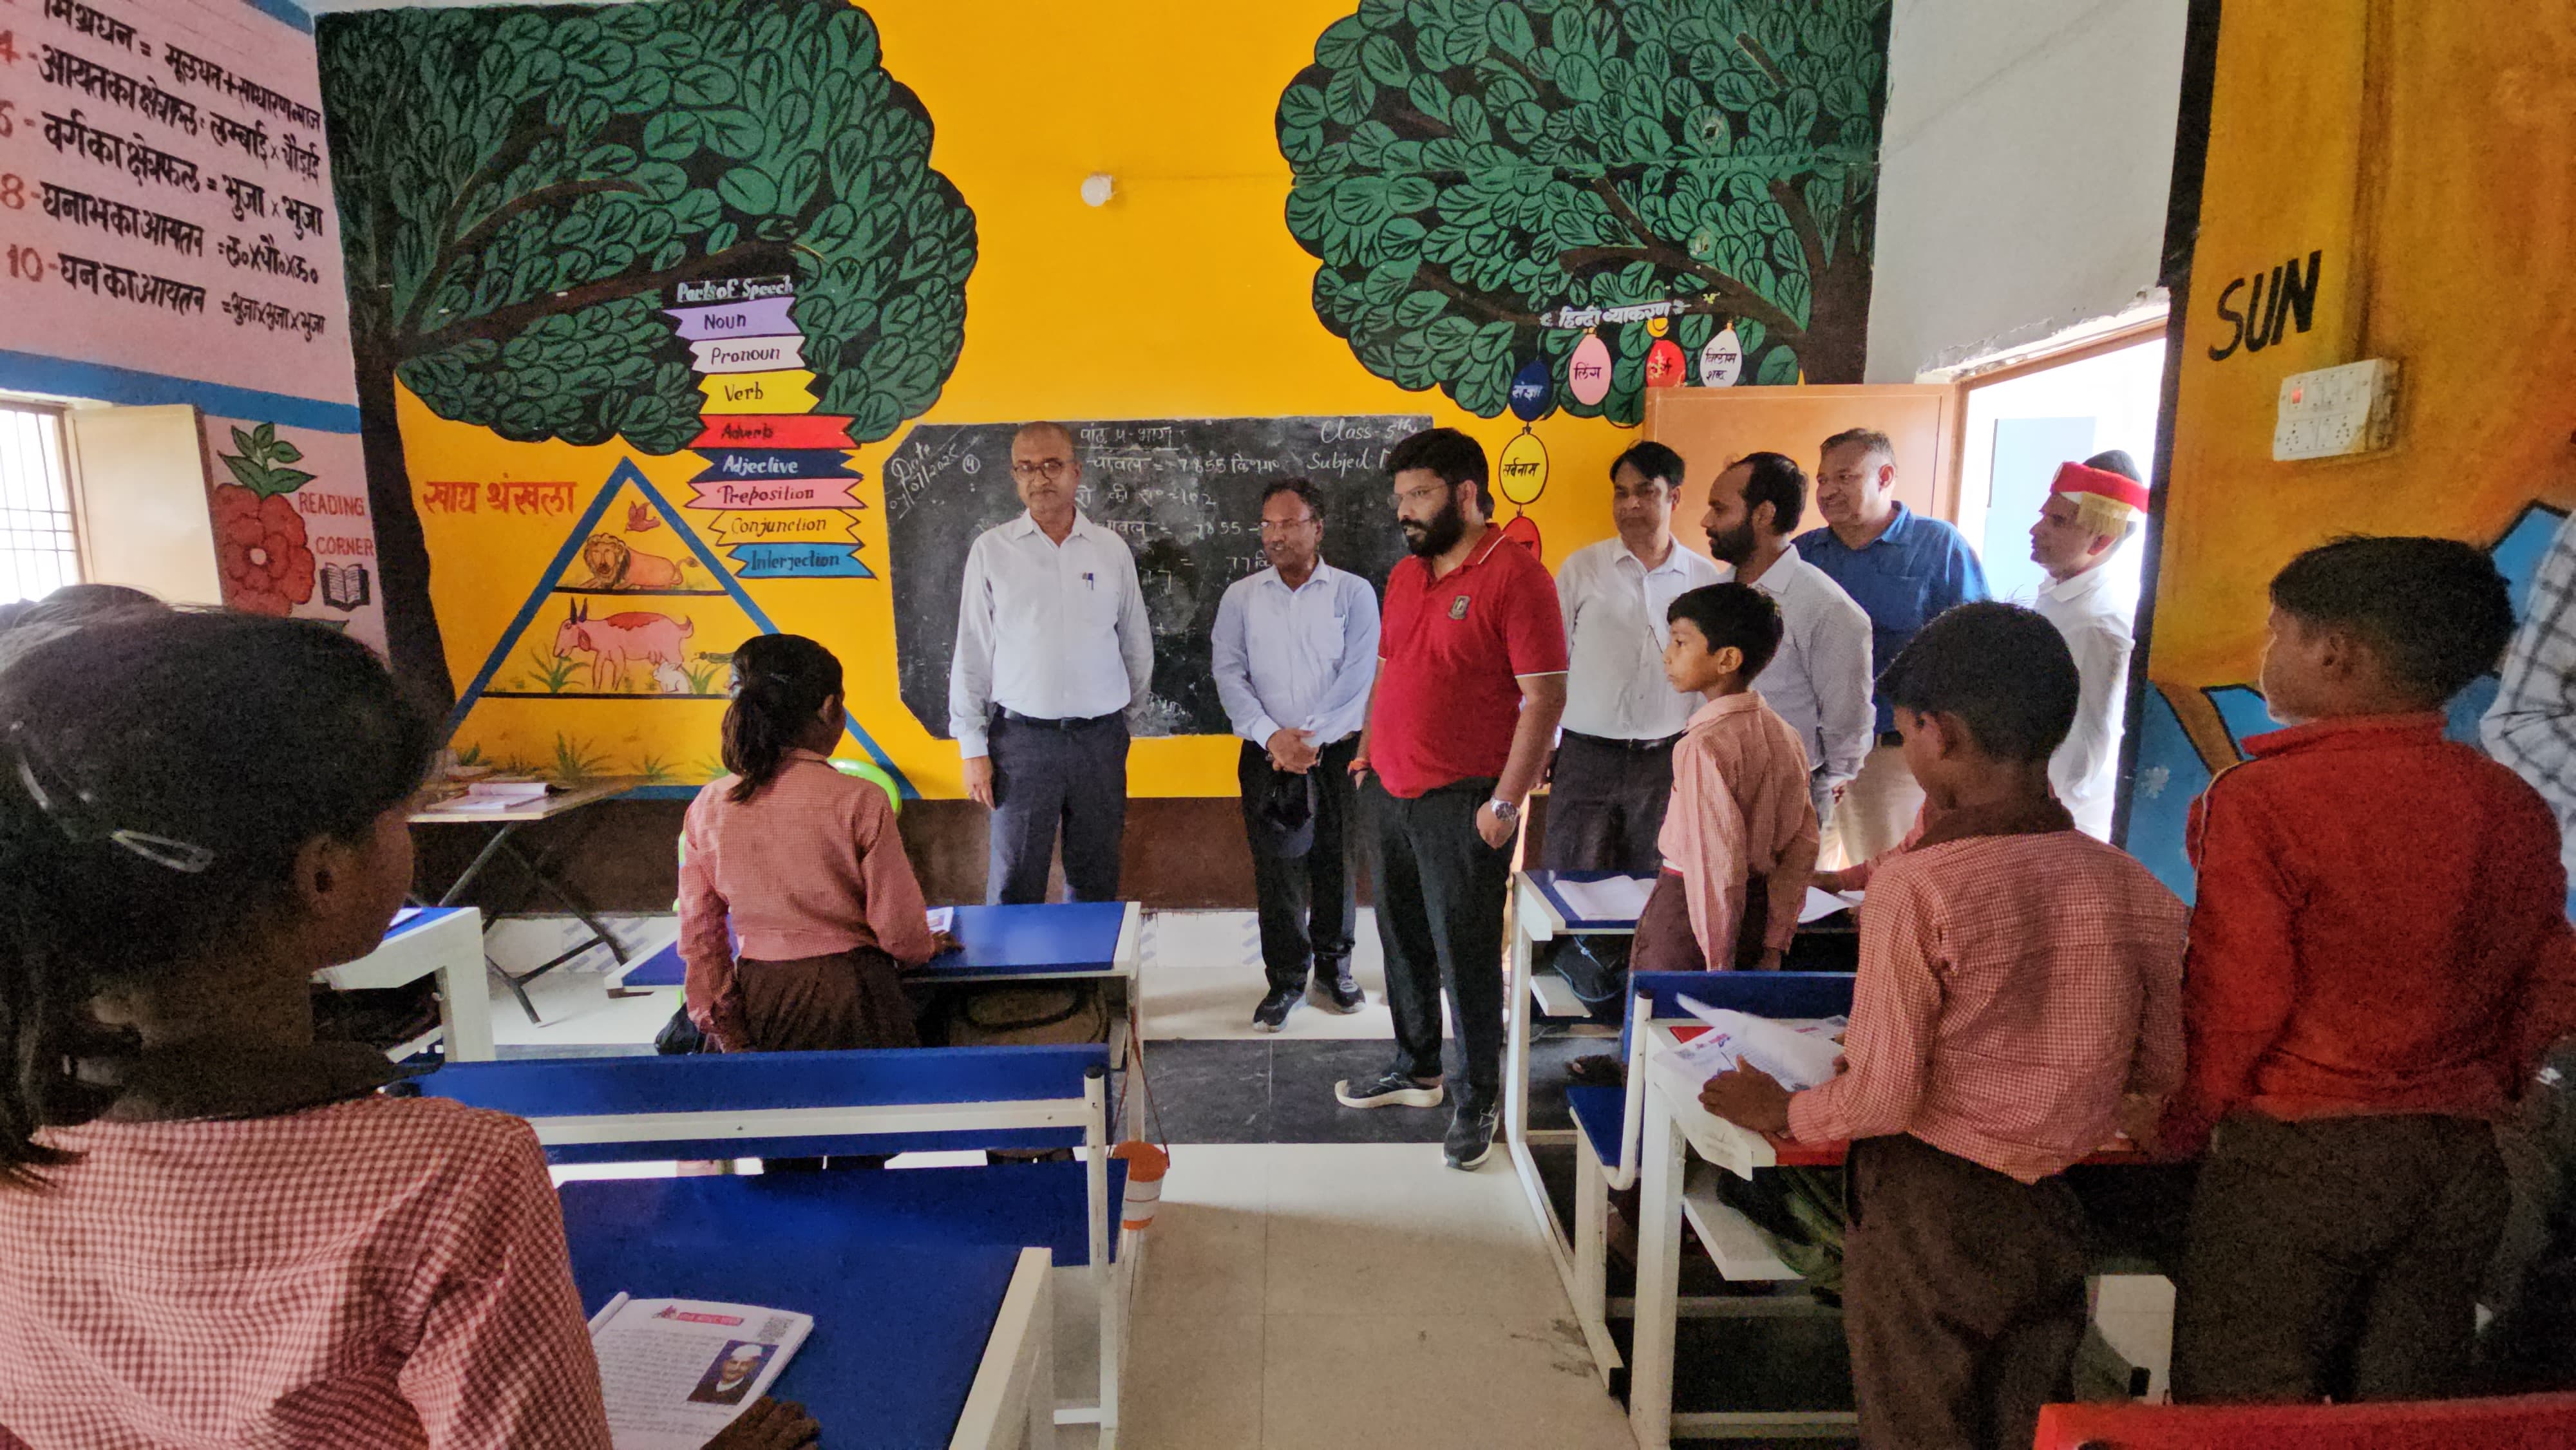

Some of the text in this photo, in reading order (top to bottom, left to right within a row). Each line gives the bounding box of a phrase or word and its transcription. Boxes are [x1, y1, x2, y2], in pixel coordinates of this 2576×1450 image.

[209, 111, 269, 170] लम्बाई
[222, 174, 265, 222] भुजा
[281, 195, 324, 241] भुजा
[742, 274, 793, 300] Speech
[1558, 301, 1672, 329] हिन्दी व्याकरण
[2208, 249, 2322, 361] SUN
[704, 314, 747, 330] Noun
[711, 346, 781, 366] Pronoun
[724, 381, 764, 402] Verb
[721, 422, 773, 440] Adverb
[722, 454, 799, 476] Adjective
[1178, 457, 1226, 473] 7855
[1502, 457, 1540, 478] सर्वनाम
[298, 491, 365, 516] READING
[422, 481, 481, 514] खाद्य
[717, 485, 814, 505] Preposition
[731, 517, 827, 538] Conjunction
[316, 536, 375, 557] CORNER
[751, 550, 840, 571] Interjection
